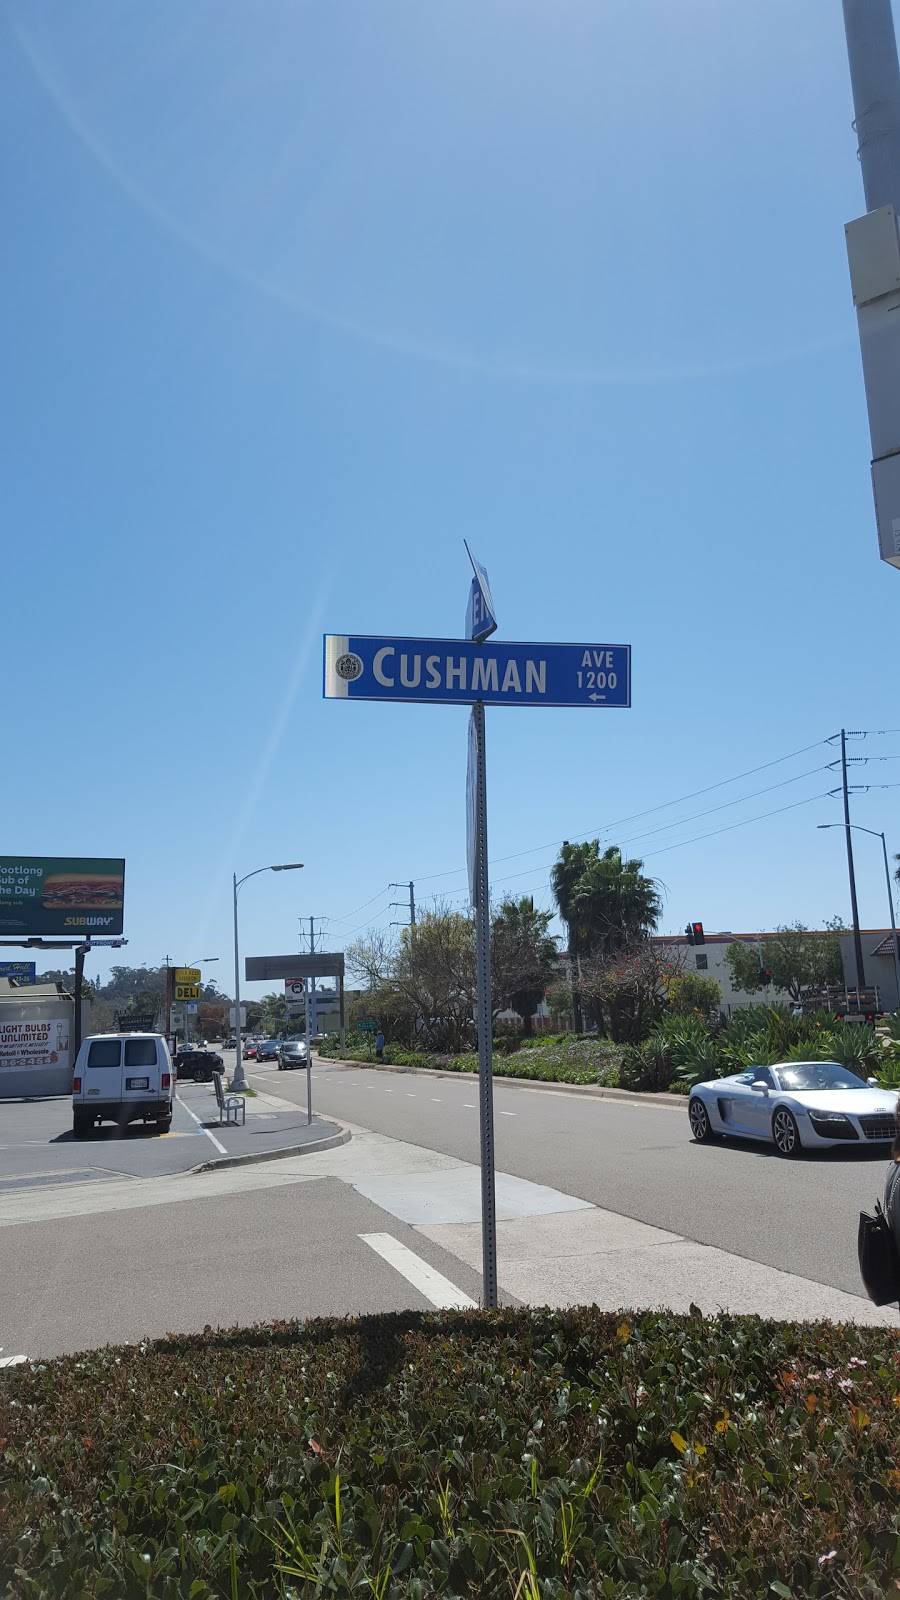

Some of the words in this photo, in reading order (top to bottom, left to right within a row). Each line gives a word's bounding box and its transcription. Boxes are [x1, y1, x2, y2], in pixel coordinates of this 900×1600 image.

[581, 650, 614, 668] AVE
[372, 646, 547, 694] CUSHMAN
[576, 671, 618, 689] 1200
[0, 865, 43, 877] ootlong
[0, 876, 15, 885] ub
[17, 875, 29, 885] of
[0, 886, 12, 895] he
[14, 886, 36, 897] Day
[64, 916, 111, 926] SUBWAY
[177, 987, 199, 998] DELI
[0, 1024, 23, 1034] LIGHT
[25, 1023, 51, 1033] BULBS
[1, 1032, 49, 1043] UNLIMITED
